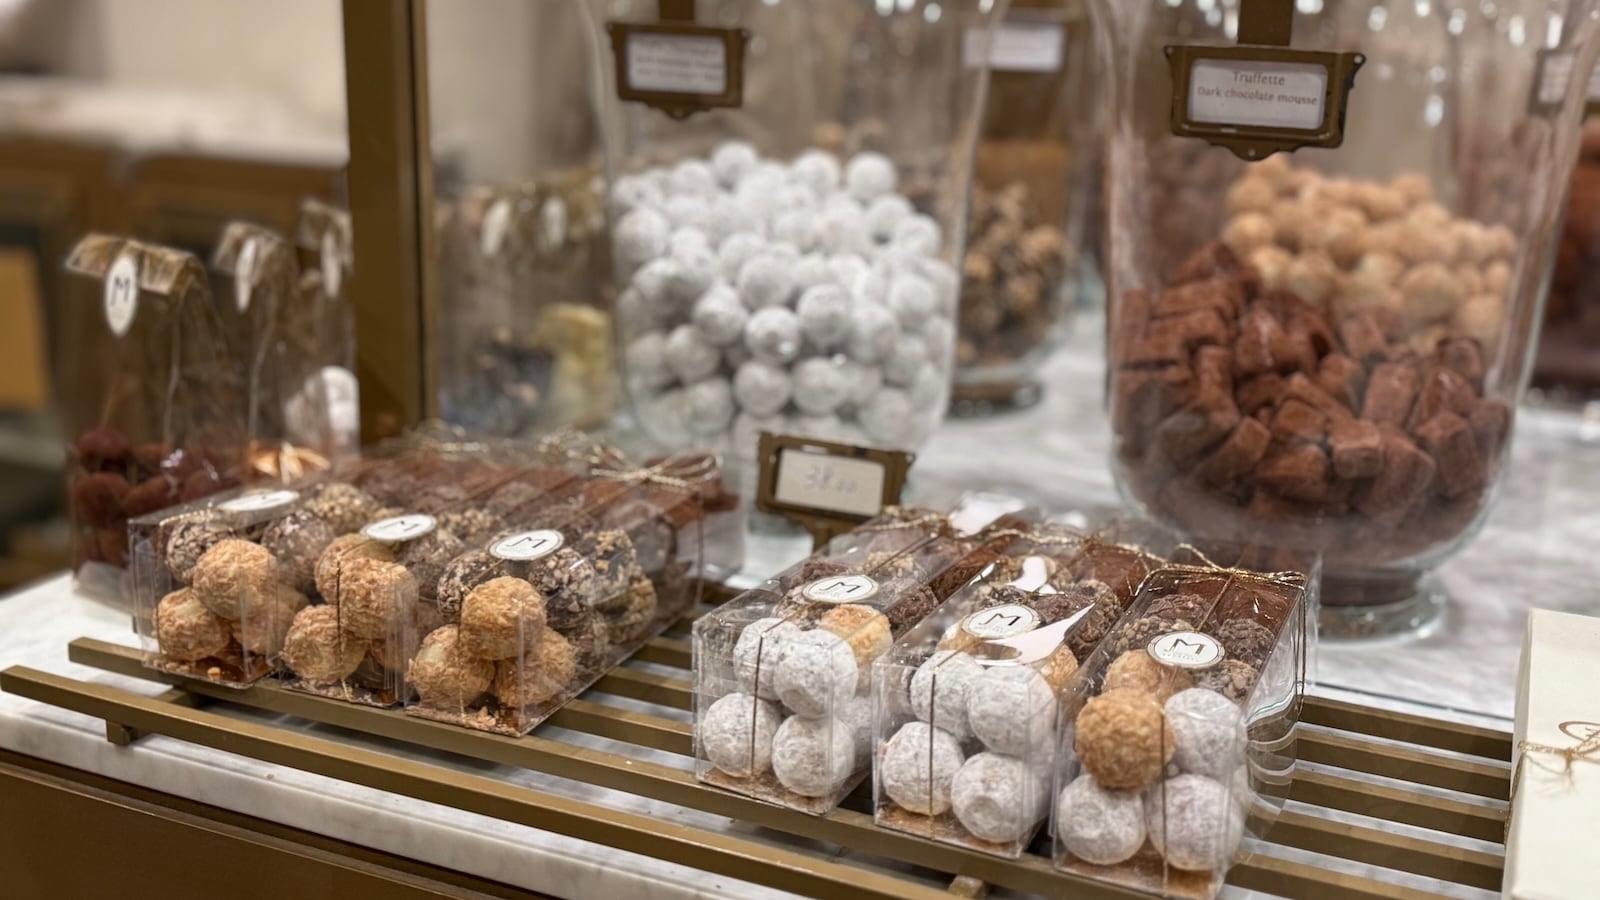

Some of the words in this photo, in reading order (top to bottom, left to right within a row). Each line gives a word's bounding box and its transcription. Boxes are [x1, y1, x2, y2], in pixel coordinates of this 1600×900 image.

[1232, 71, 1286, 86] Truffette
[1197, 85, 1221, 97] Dark
[1224, 88, 1274, 102] chocolate
[1277, 94, 1318, 105] mousse
[110, 276, 131, 307] M
[818, 581, 862, 593] M
[978, 612, 1022, 626] M
[1163, 638, 1208, 655] M
